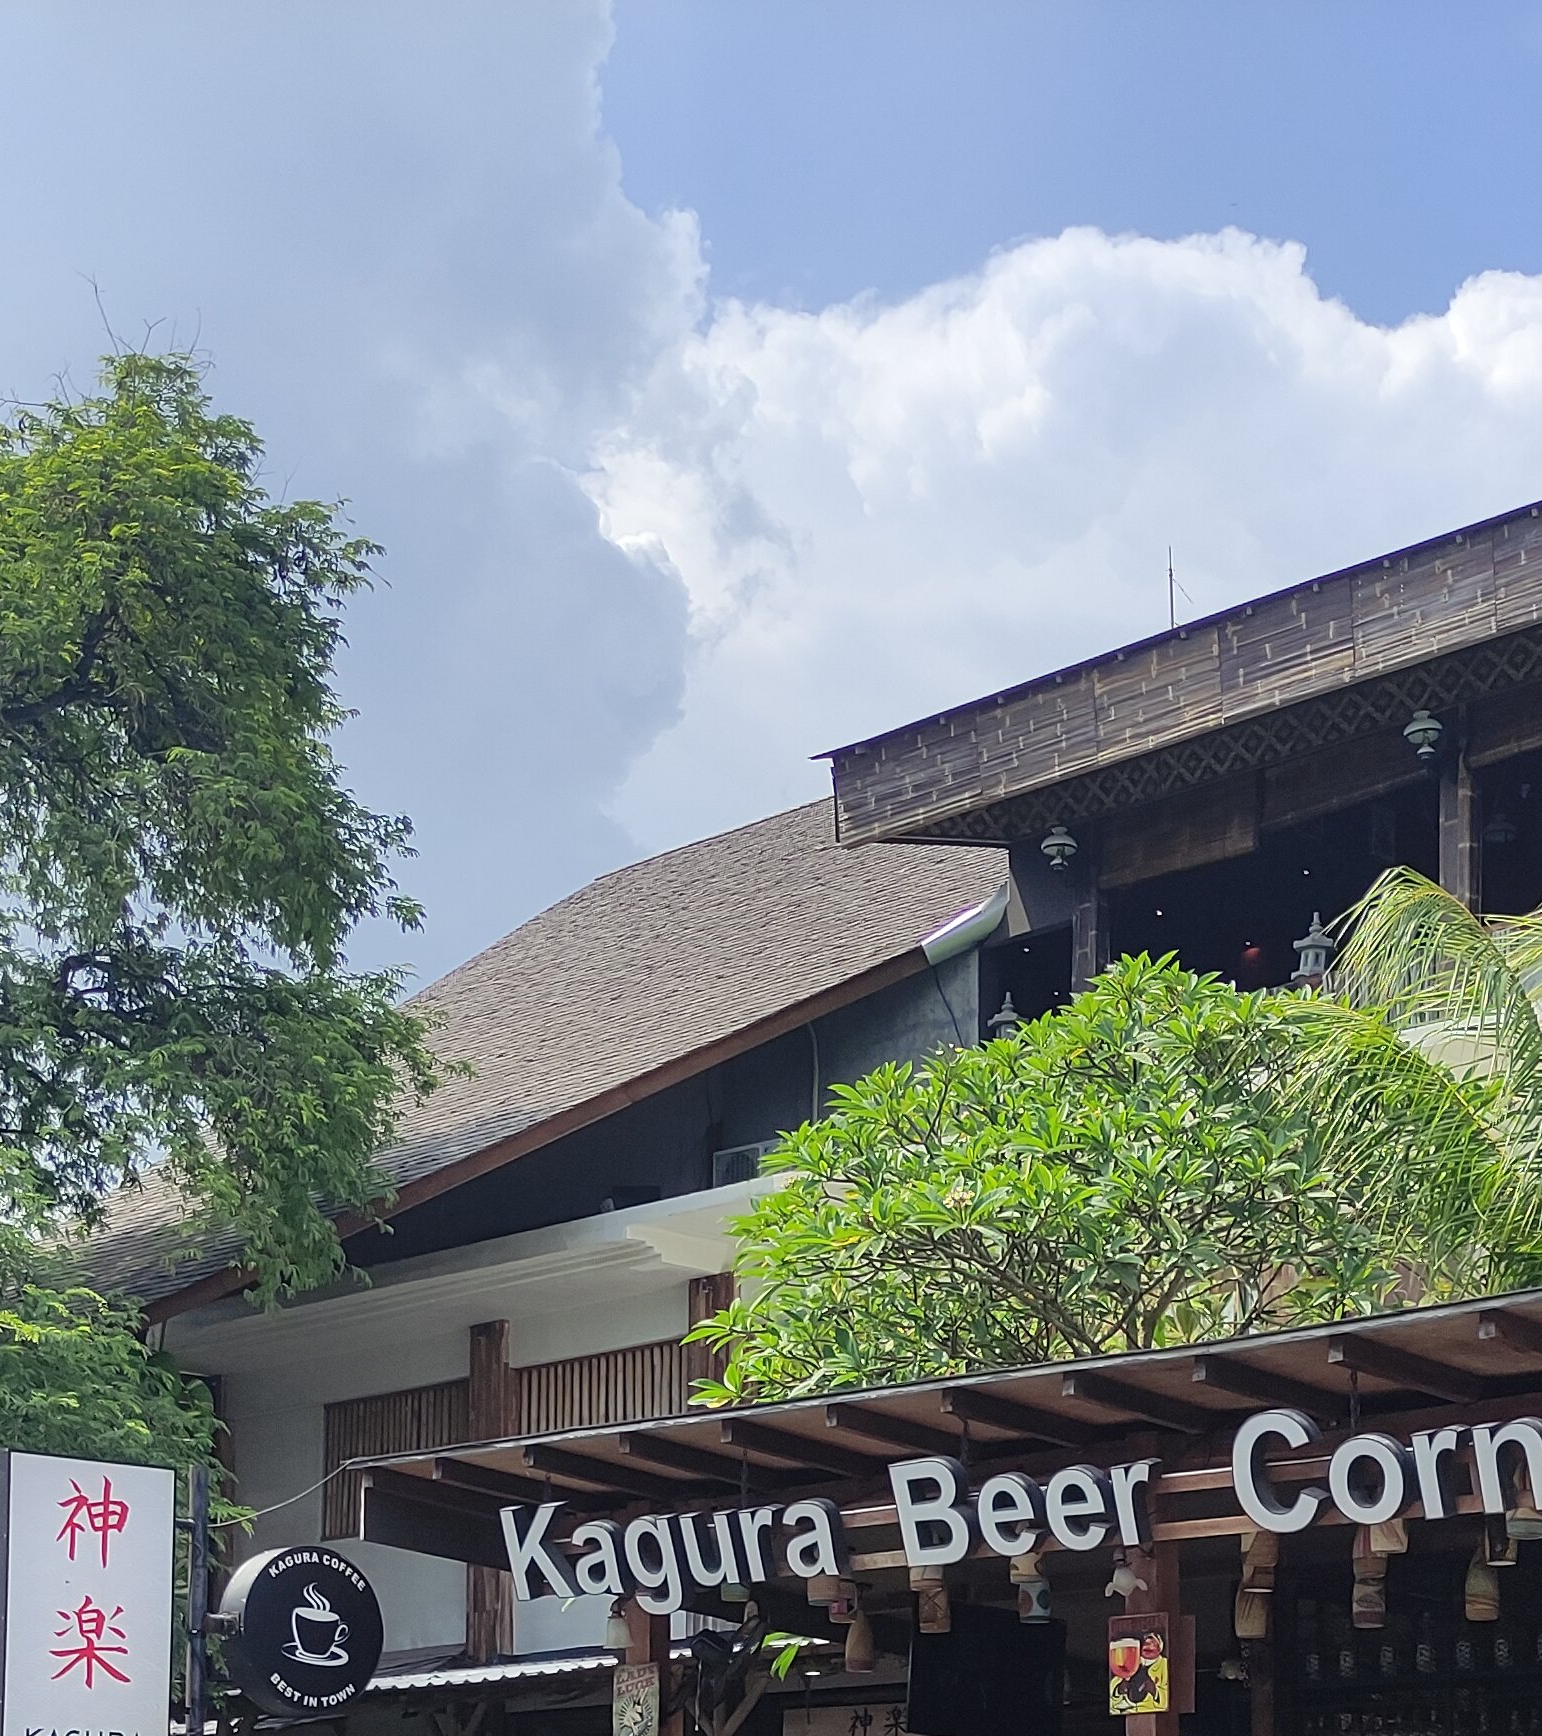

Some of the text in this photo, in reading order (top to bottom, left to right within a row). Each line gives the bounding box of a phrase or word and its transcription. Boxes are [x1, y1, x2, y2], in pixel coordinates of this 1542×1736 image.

[49, 1474, 132, 1690] 神楽
[269, 1552, 366, 1592] KAGURA COFFEE
[499, 1498, 841, 1615] Kagura
[888, 1457, 1155, 1568] Beer
[270, 1672, 356, 1707] BEST IN TOWN
